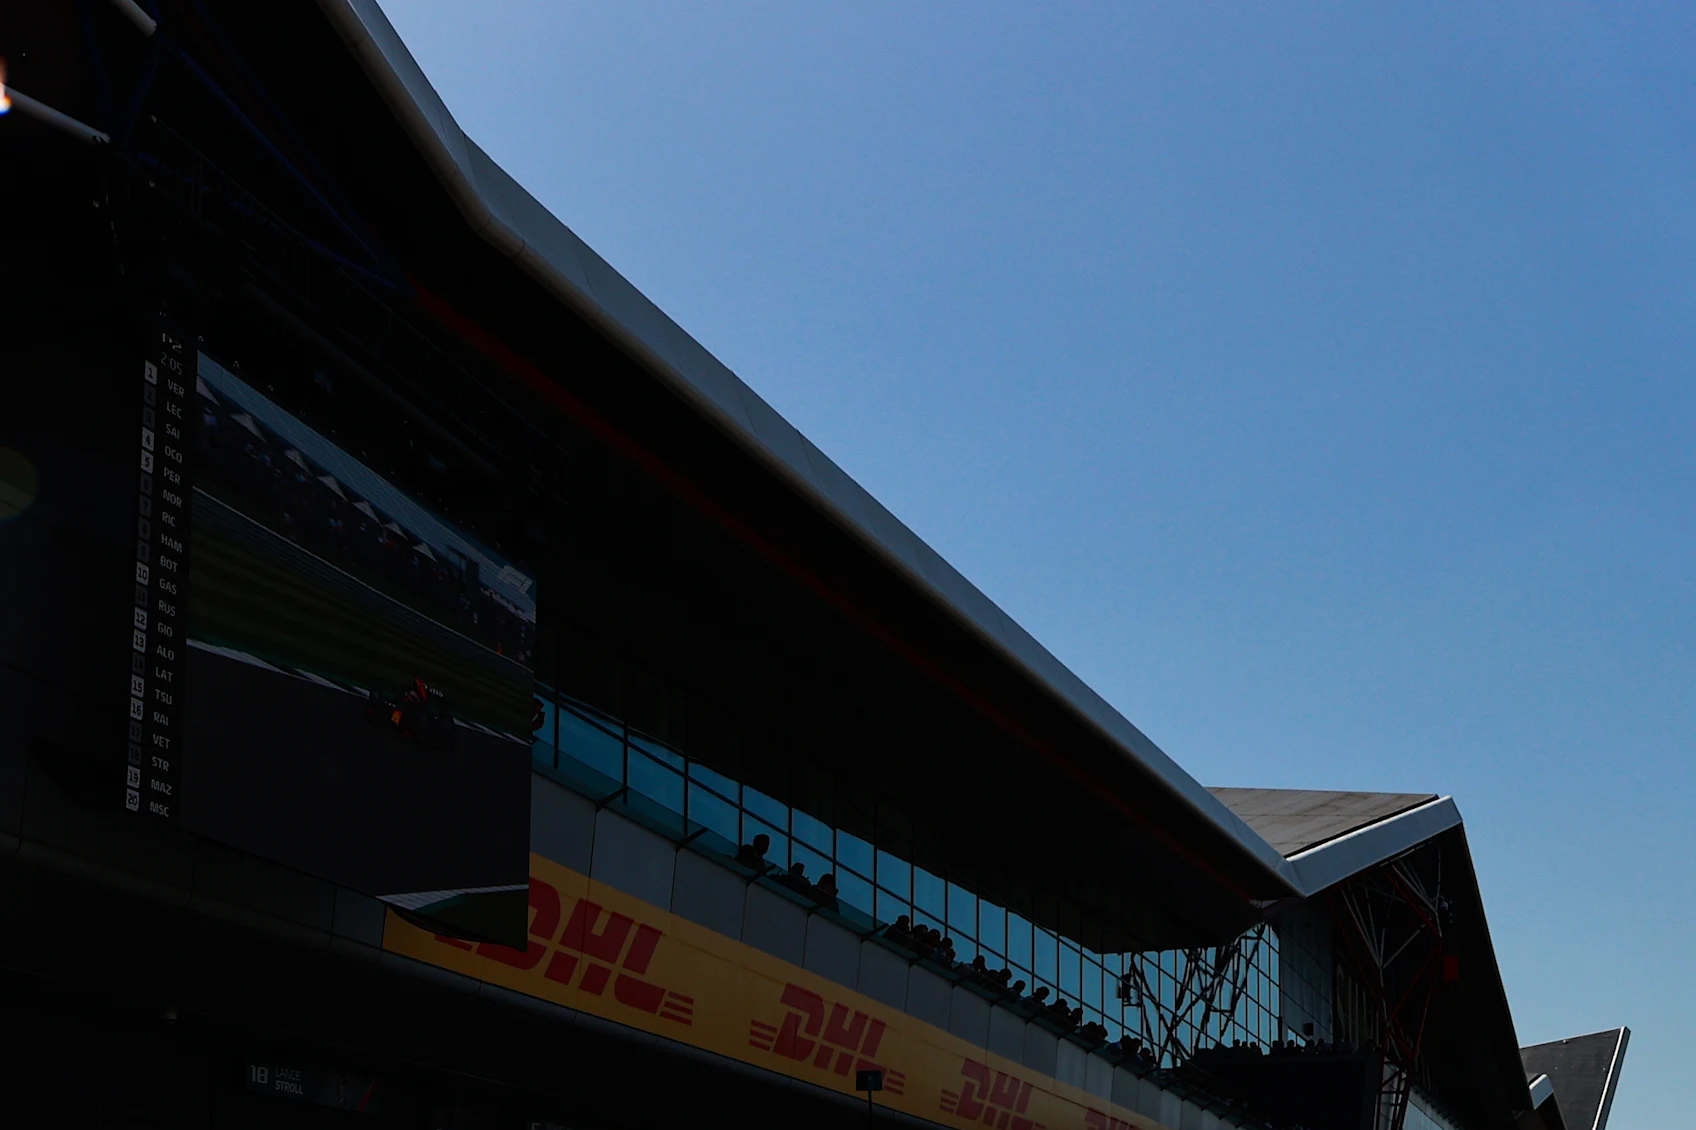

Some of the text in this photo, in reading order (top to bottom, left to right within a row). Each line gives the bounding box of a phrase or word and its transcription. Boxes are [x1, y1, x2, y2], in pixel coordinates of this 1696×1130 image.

[167, 379, 184, 398] VER
[166, 401, 182, 419] LEC
[165, 423, 180, 440] SAI
[164, 445, 183, 464] OCO
[163, 467, 181, 486] PER
[162, 489, 183, 508] NOR
[161, 511, 176, 527] RIC
[160, 533, 183, 554] HAM
[159, 555, 179, 573] BOT
[159, 577, 177, 596] GAS
[158, 600, 176, 617] RUS
[157, 622, 173, 638] GIO
[156, 645, 174, 661] ALO
[155, 666, 173, 683] LAT
[154, 688, 173, 705] TSU
[153, 711, 169, 726] RAI
[153, 733, 171, 750] VET
[151, 756, 170, 772] STR
[151, 778, 172, 795] MAZ
[149, 801, 170, 818] MSC
[476, 877, 666, 1014] DHL
[773, 982, 887, 1084] DHL
[250, 1064, 268, 1085] 18
[275, 1066, 302, 1082] LANCE
[274, 1080, 304, 1095] STROLL
